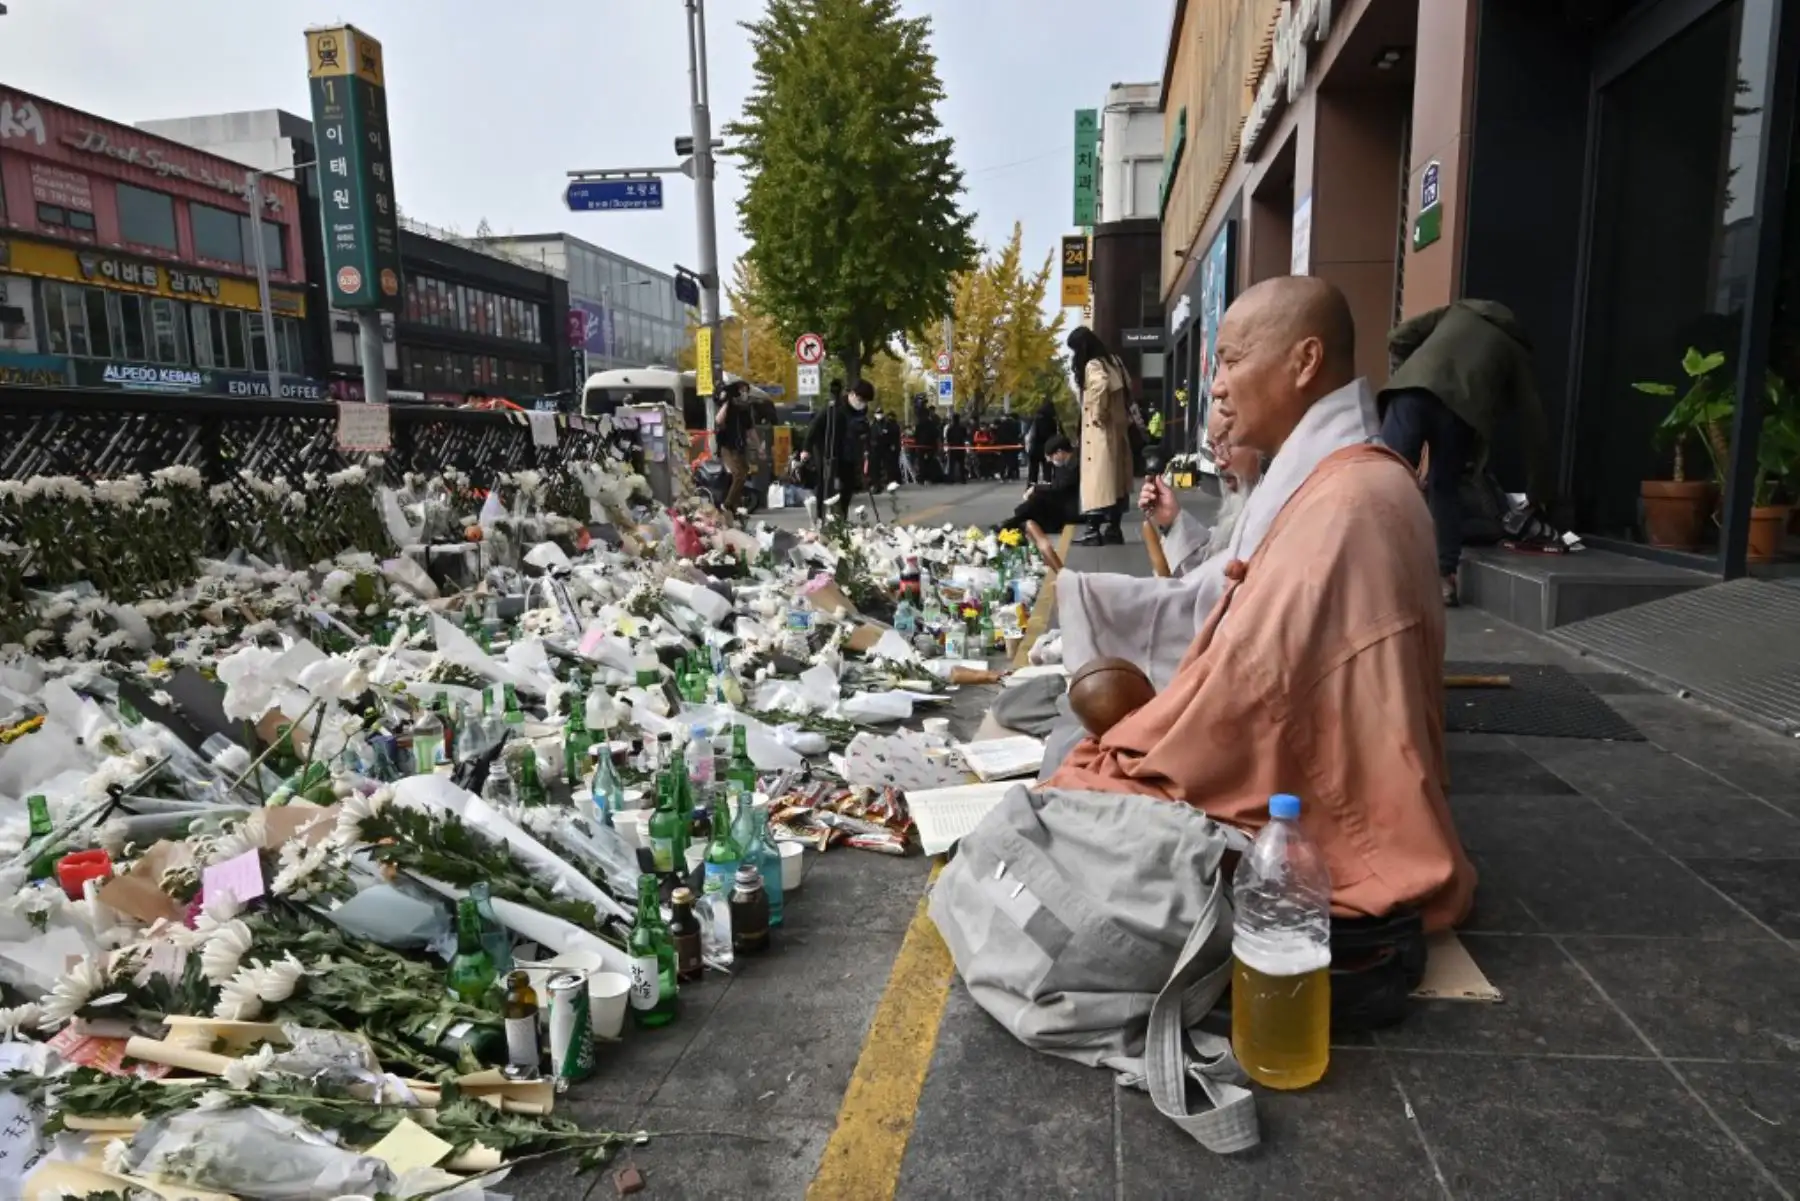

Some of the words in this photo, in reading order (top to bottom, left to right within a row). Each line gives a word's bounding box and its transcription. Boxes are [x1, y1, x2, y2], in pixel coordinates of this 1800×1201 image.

[325, 79, 335, 105] 1
[326, 124, 351, 210] 이태원
[1065, 250, 1085, 264] 24
[104, 365, 157, 382] ALPEDO
[158, 367, 202, 385] KEBAB
[228, 380, 268, 396] EDIYA
[280, 385, 320, 399] OFFEE
